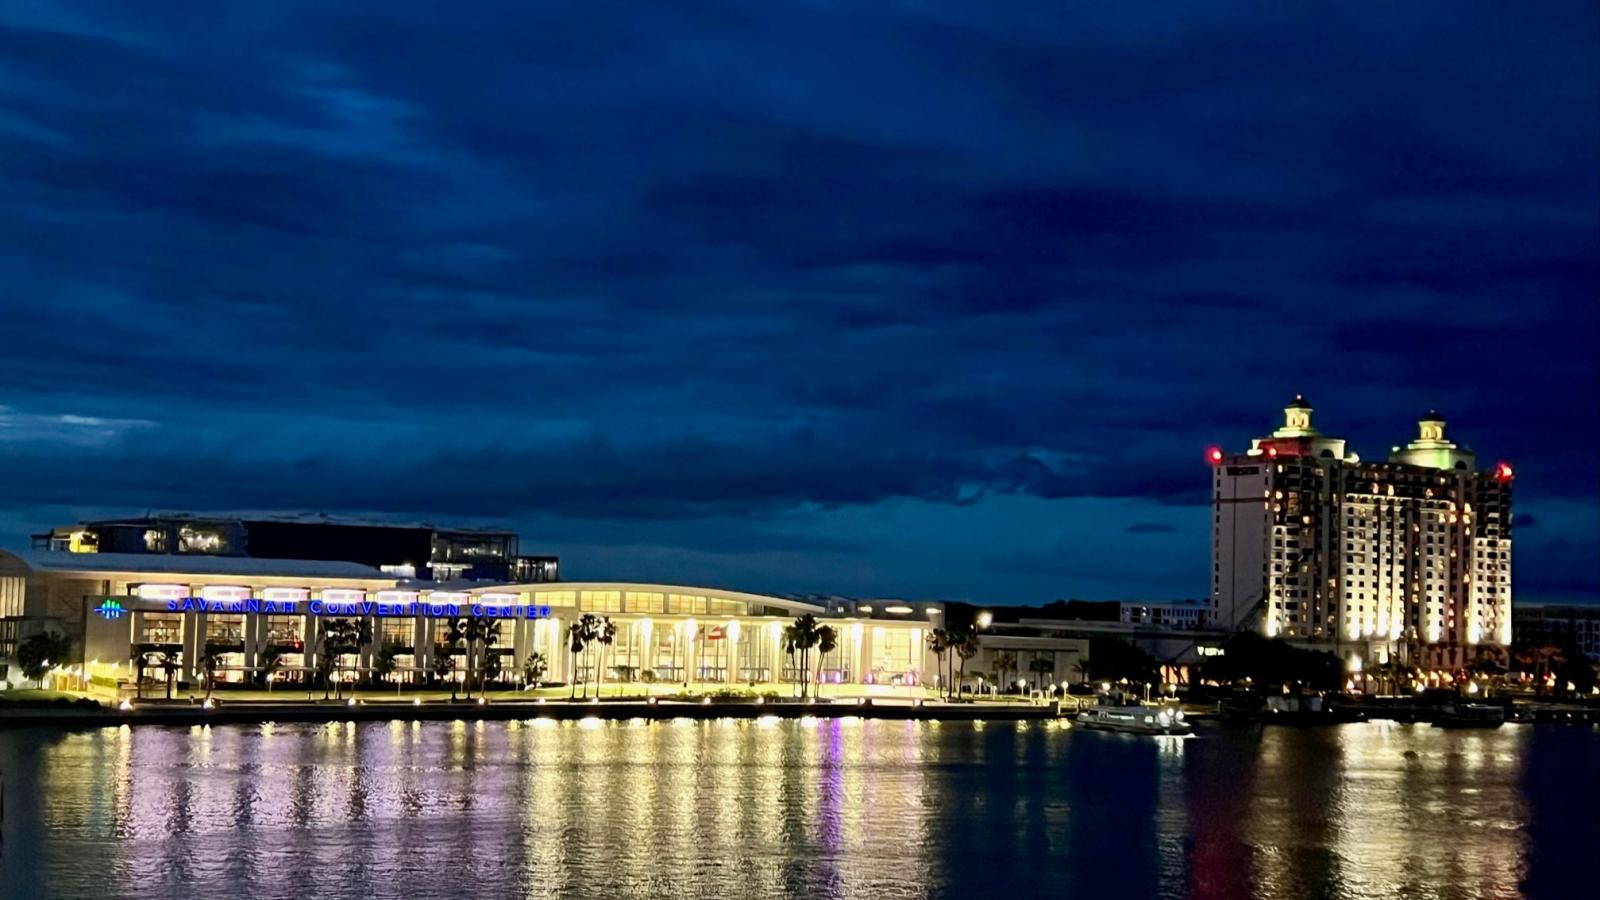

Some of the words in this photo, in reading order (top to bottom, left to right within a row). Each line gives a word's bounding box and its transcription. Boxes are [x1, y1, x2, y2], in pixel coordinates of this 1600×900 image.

[167, 598, 296, 613] SAVANNAH
[310, 600, 460, 616] CONVENTION
[472, 603, 550, 618] CENTER
